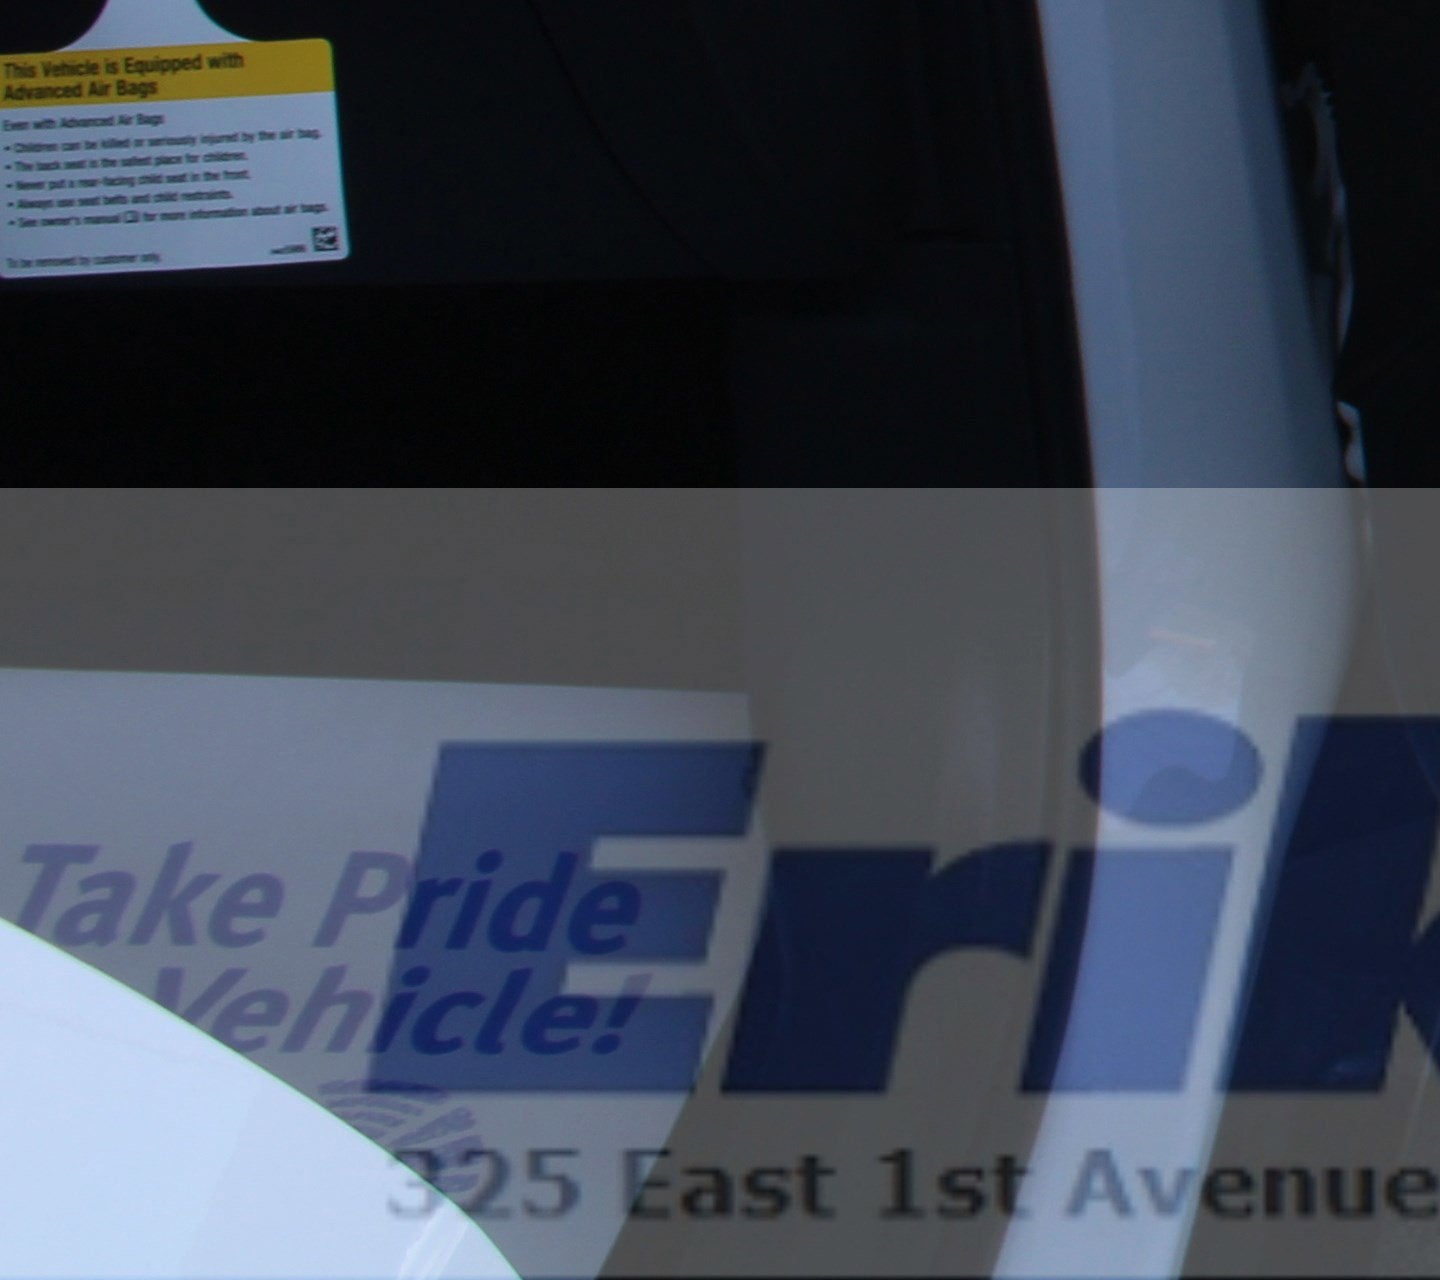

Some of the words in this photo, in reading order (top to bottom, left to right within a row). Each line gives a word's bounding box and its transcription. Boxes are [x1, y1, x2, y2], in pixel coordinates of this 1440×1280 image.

[4, 62, 36, 78] This
[41, 60, 99, 76] Vehicle
[105, 59, 118, 74] is
[124, 53, 202, 76] Equipped
[208, 52, 244, 68] with
[4, 84, 82, 100] Advanced
[88, 81, 111, 96] Air
[116, 80, 158, 98] Bags
[11, 840, 286, 949] Take
[313, 848, 643, 955] Pride
[150, 964, 653, 1057] Vehicle!
